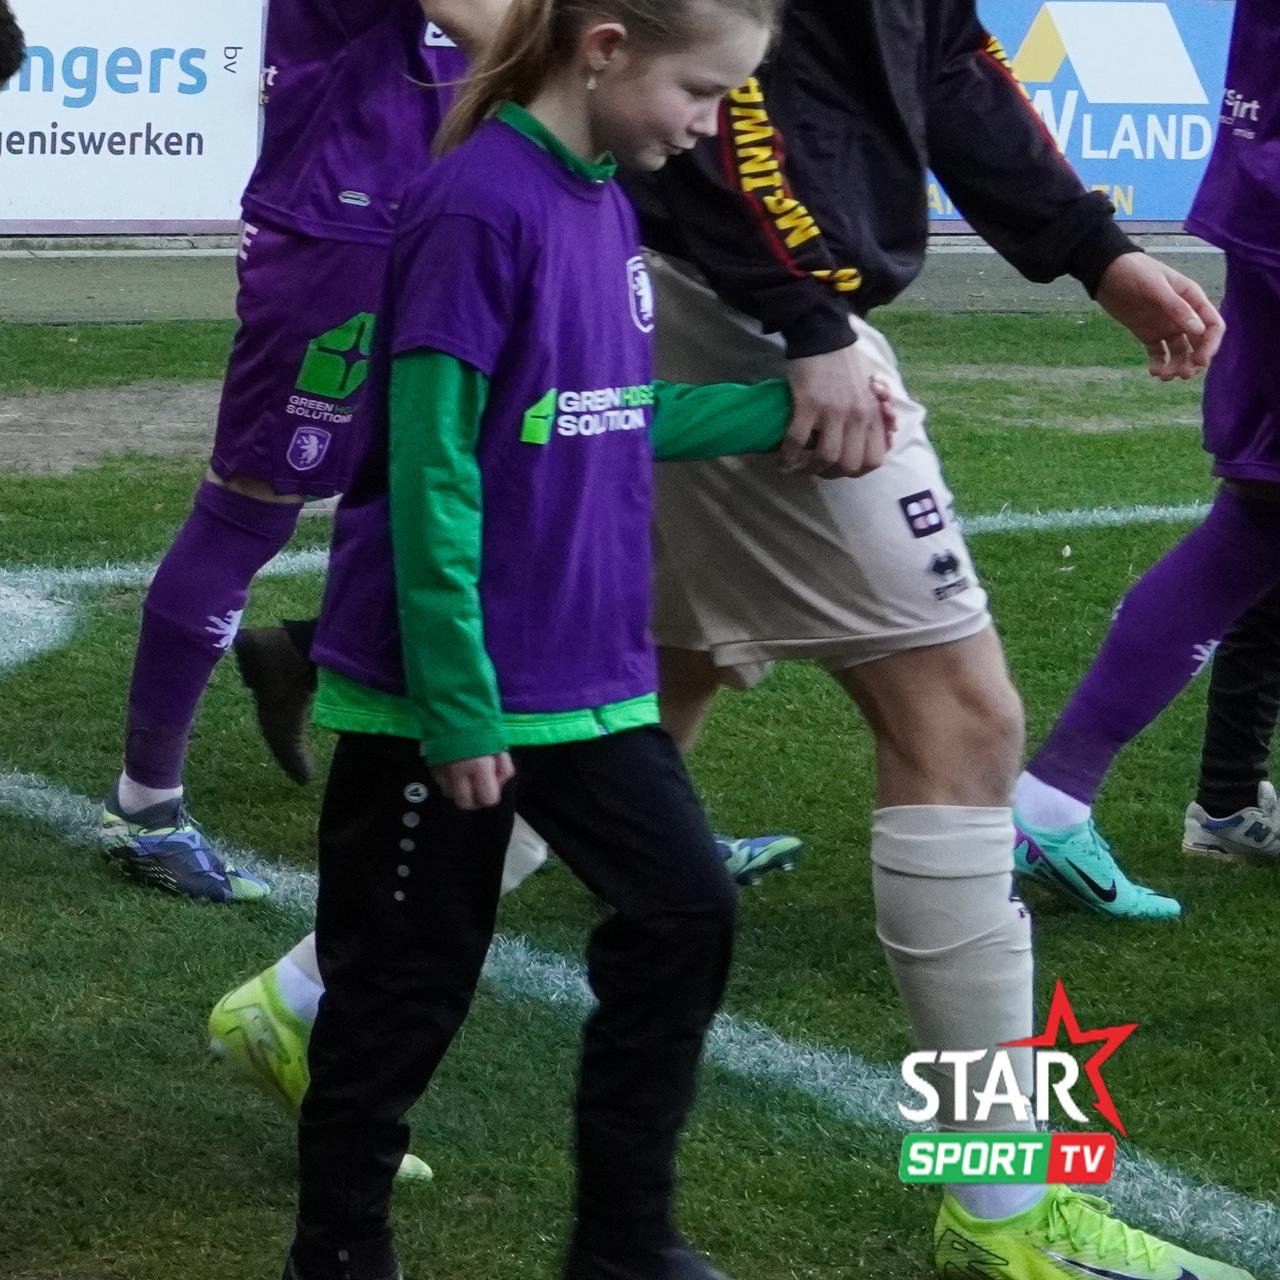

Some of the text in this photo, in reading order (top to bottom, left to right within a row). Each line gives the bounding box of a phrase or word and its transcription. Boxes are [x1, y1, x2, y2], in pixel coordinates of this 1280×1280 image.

[0, 44, 208, 109] ngers
[223, 46, 244, 74] bv
[289, 394, 335, 414] GREEN
